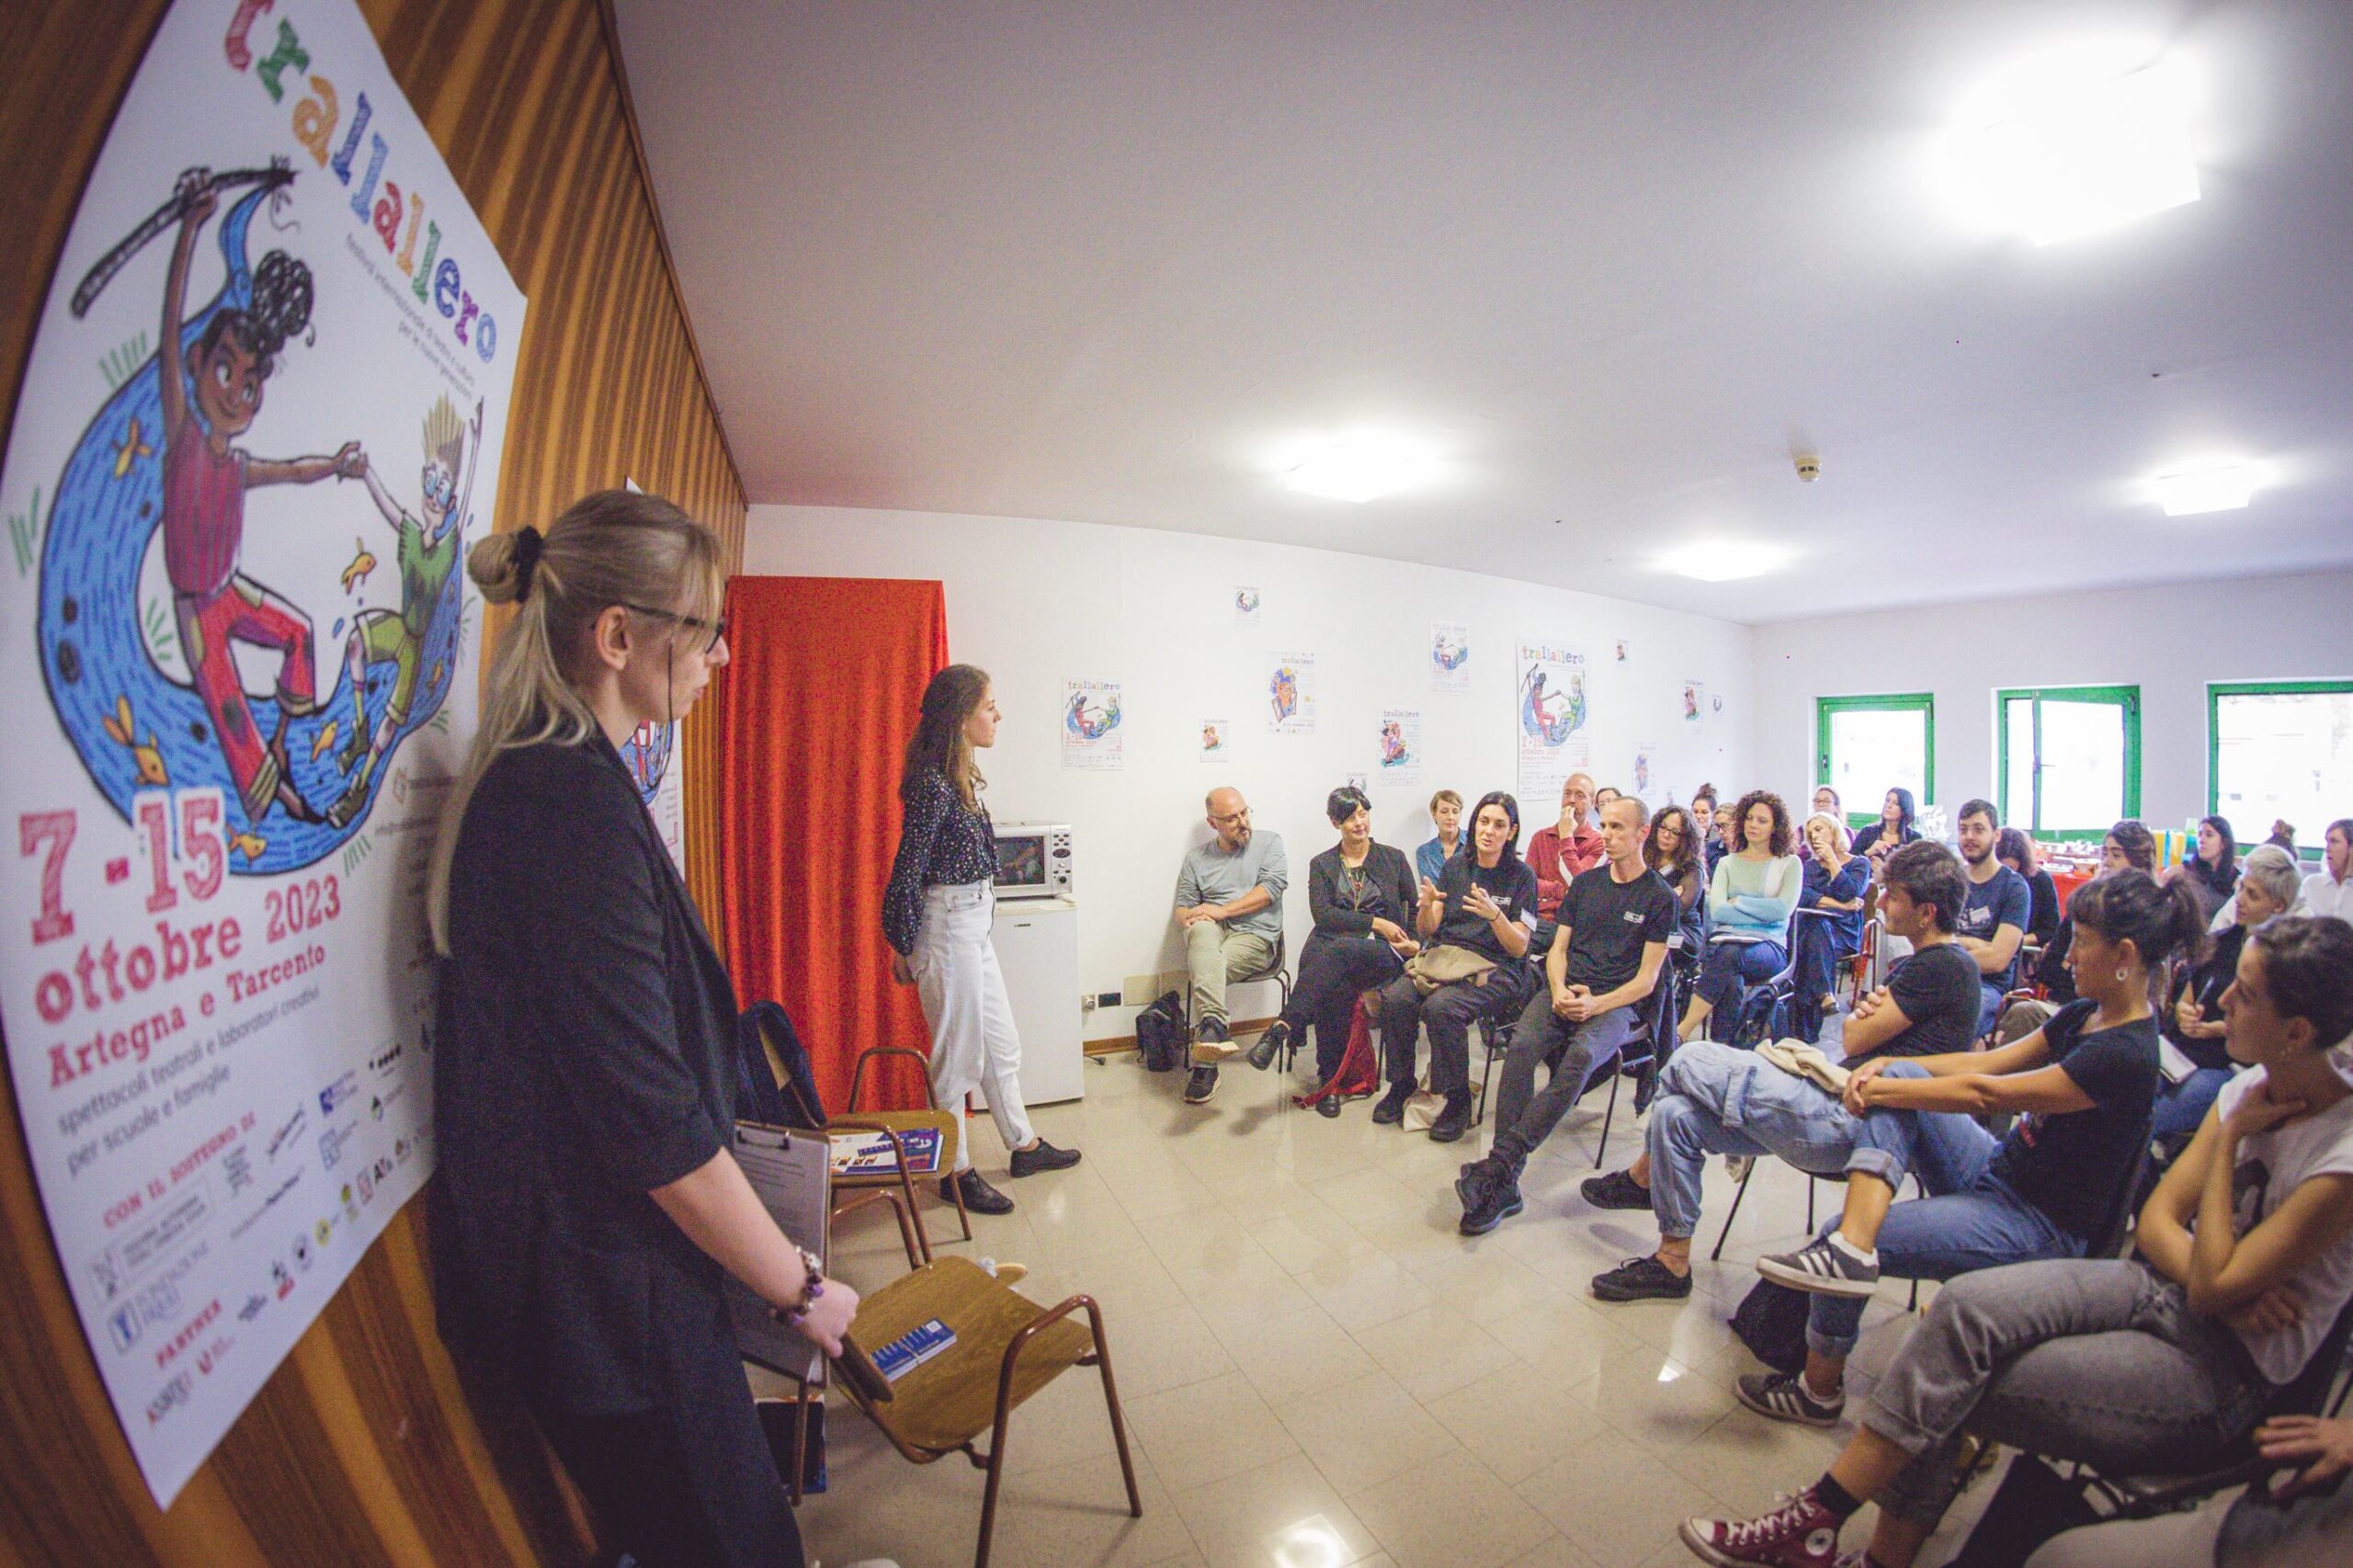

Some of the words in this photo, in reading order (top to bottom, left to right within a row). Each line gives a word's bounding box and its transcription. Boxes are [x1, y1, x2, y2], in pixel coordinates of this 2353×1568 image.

[35, 916, 242, 1024] ottobre
[264, 874, 341, 945] 2023
[48, 1006, 187, 1088] Artegna
[199, 991, 216, 1017] e
[226, 943, 325, 1003] Tarcento
[57, 1067, 148, 1136] spettacoli
[151, 1044, 204, 1088] teatrali
[65, 1137, 99, 1178] per
[102, 1103, 160, 1159] scuole
[162, 1096, 174, 1118] e
[174, 1063, 231, 1108] famiglie
[102, 1193, 143, 1230] CON
[156, 1298, 222, 1368] PARTNER
